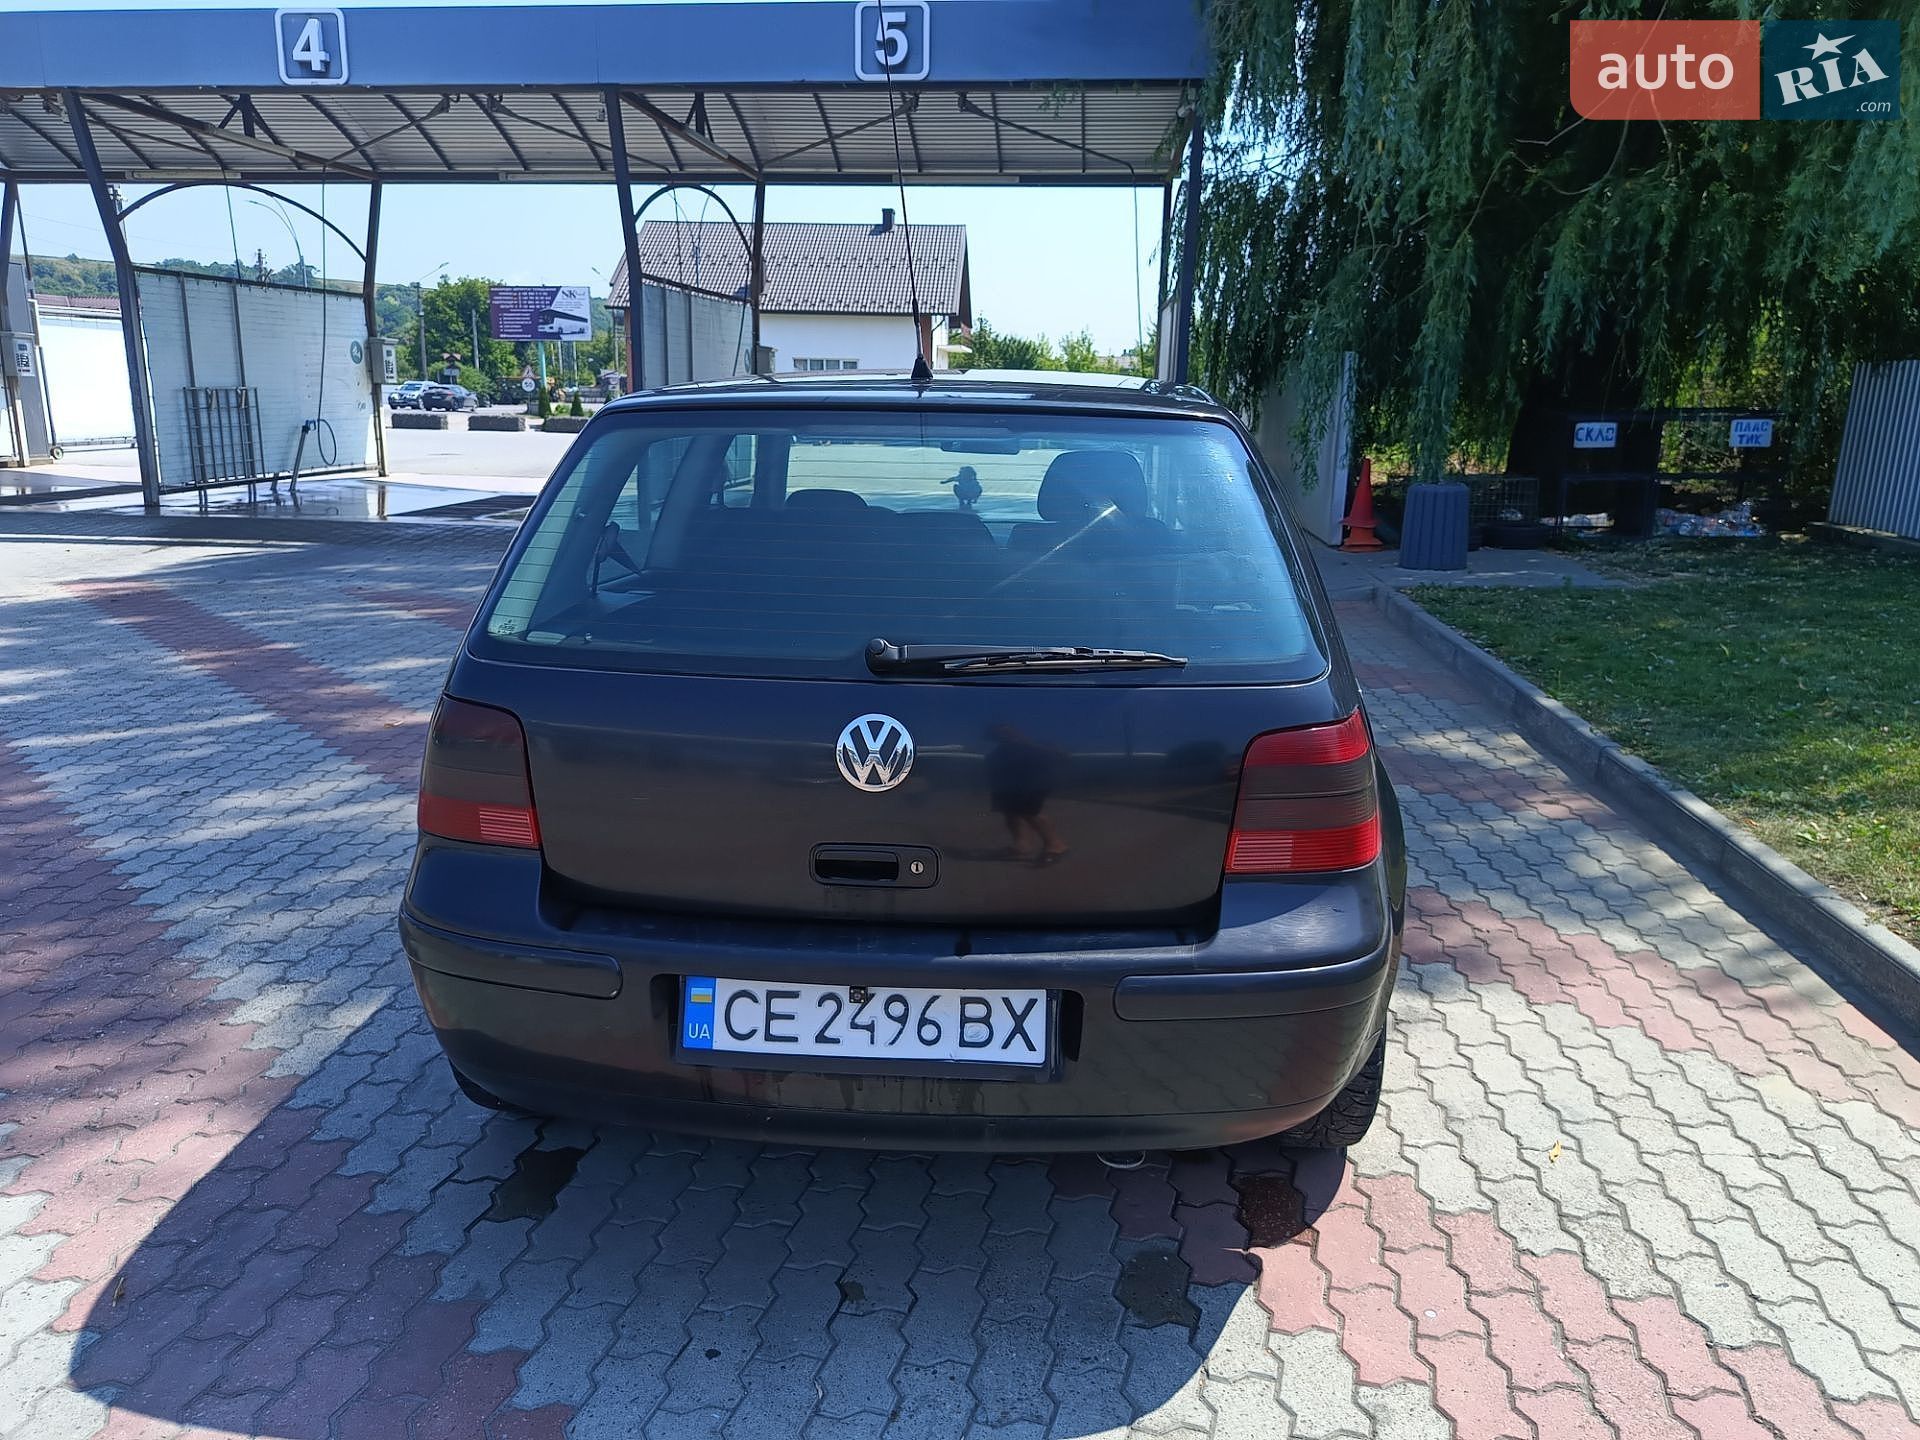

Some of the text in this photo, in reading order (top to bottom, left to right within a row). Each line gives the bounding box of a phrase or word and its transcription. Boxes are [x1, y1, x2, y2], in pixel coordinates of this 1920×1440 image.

[292, 18, 330, 72] 4
[875, 11, 908, 66] 5
[1738, 433, 1762, 445] ТИК
[688, 1023, 711, 1040] UA
[724, 989, 1038, 1052] CE 2496 BX
